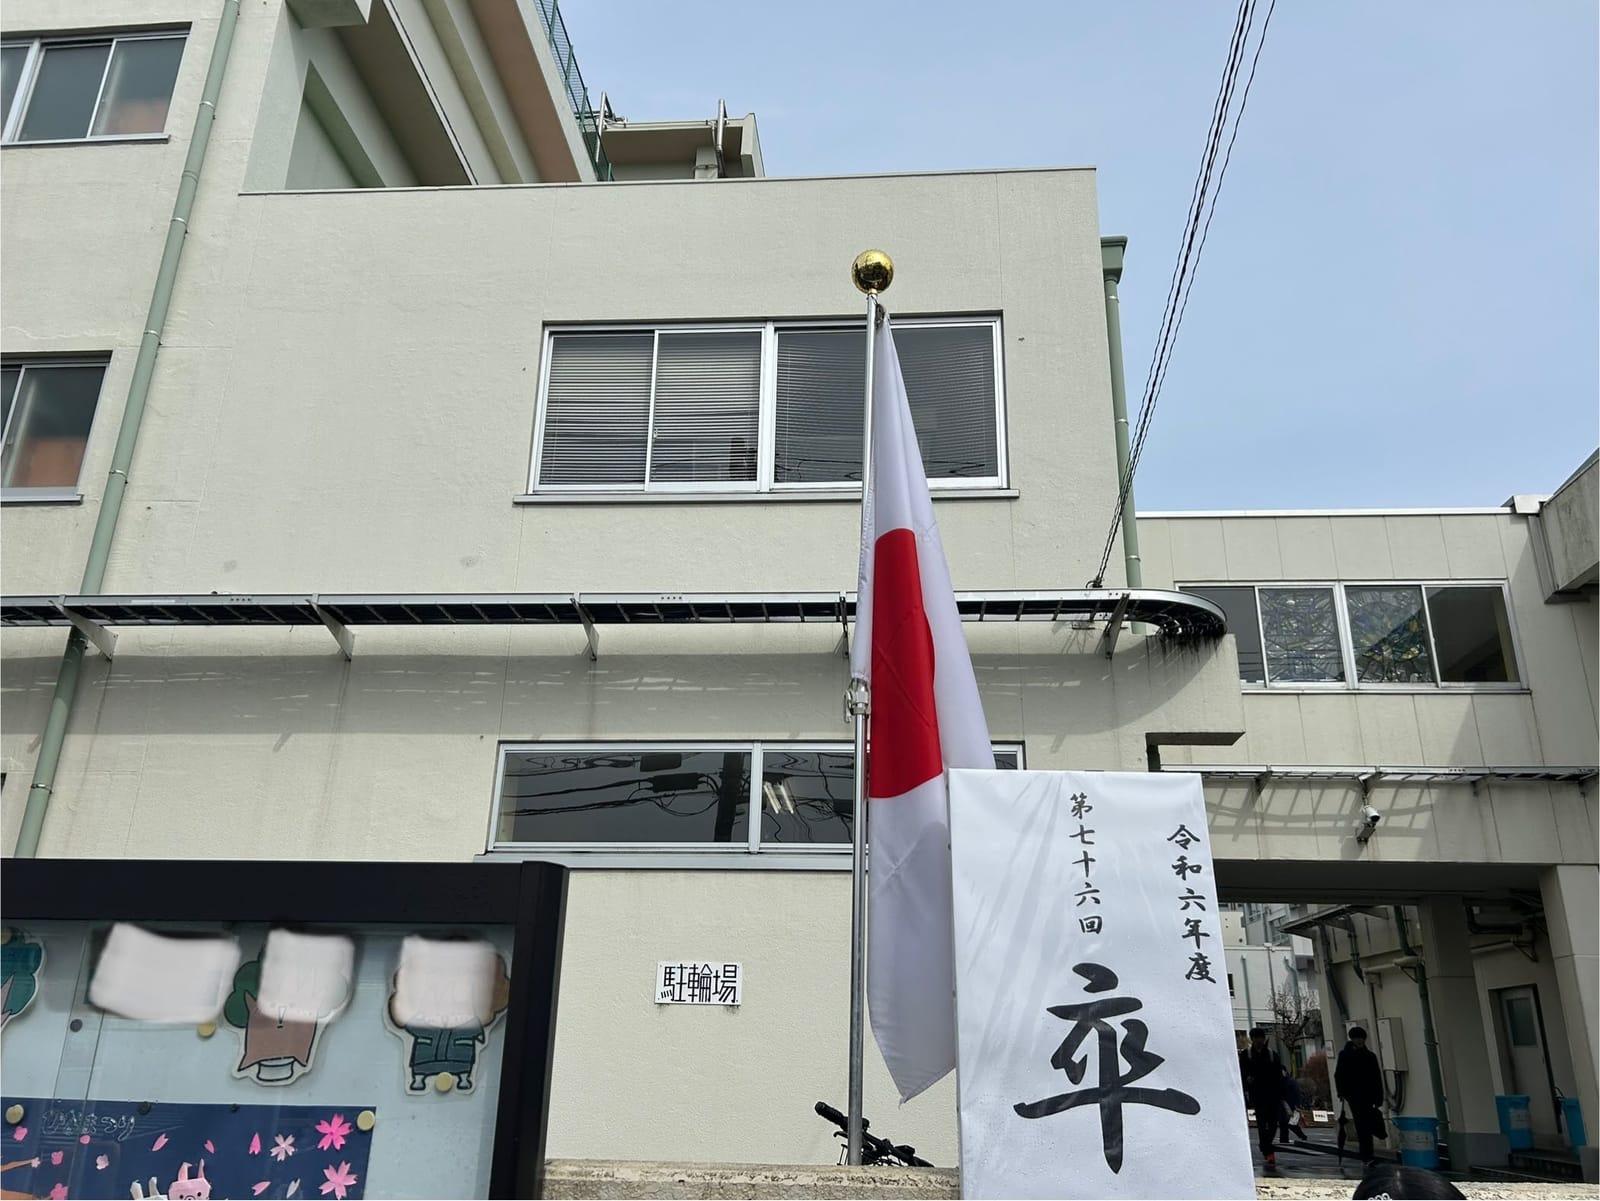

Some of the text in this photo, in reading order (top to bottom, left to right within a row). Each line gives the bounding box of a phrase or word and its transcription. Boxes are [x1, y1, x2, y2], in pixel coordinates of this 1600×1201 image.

[1069, 792, 1103, 935] 第七十六回
[1166, 824, 1217, 984] 令和六年度
[660, 963, 737, 1003] 駐輪場
[1012, 962, 1201, 1175] 卒
